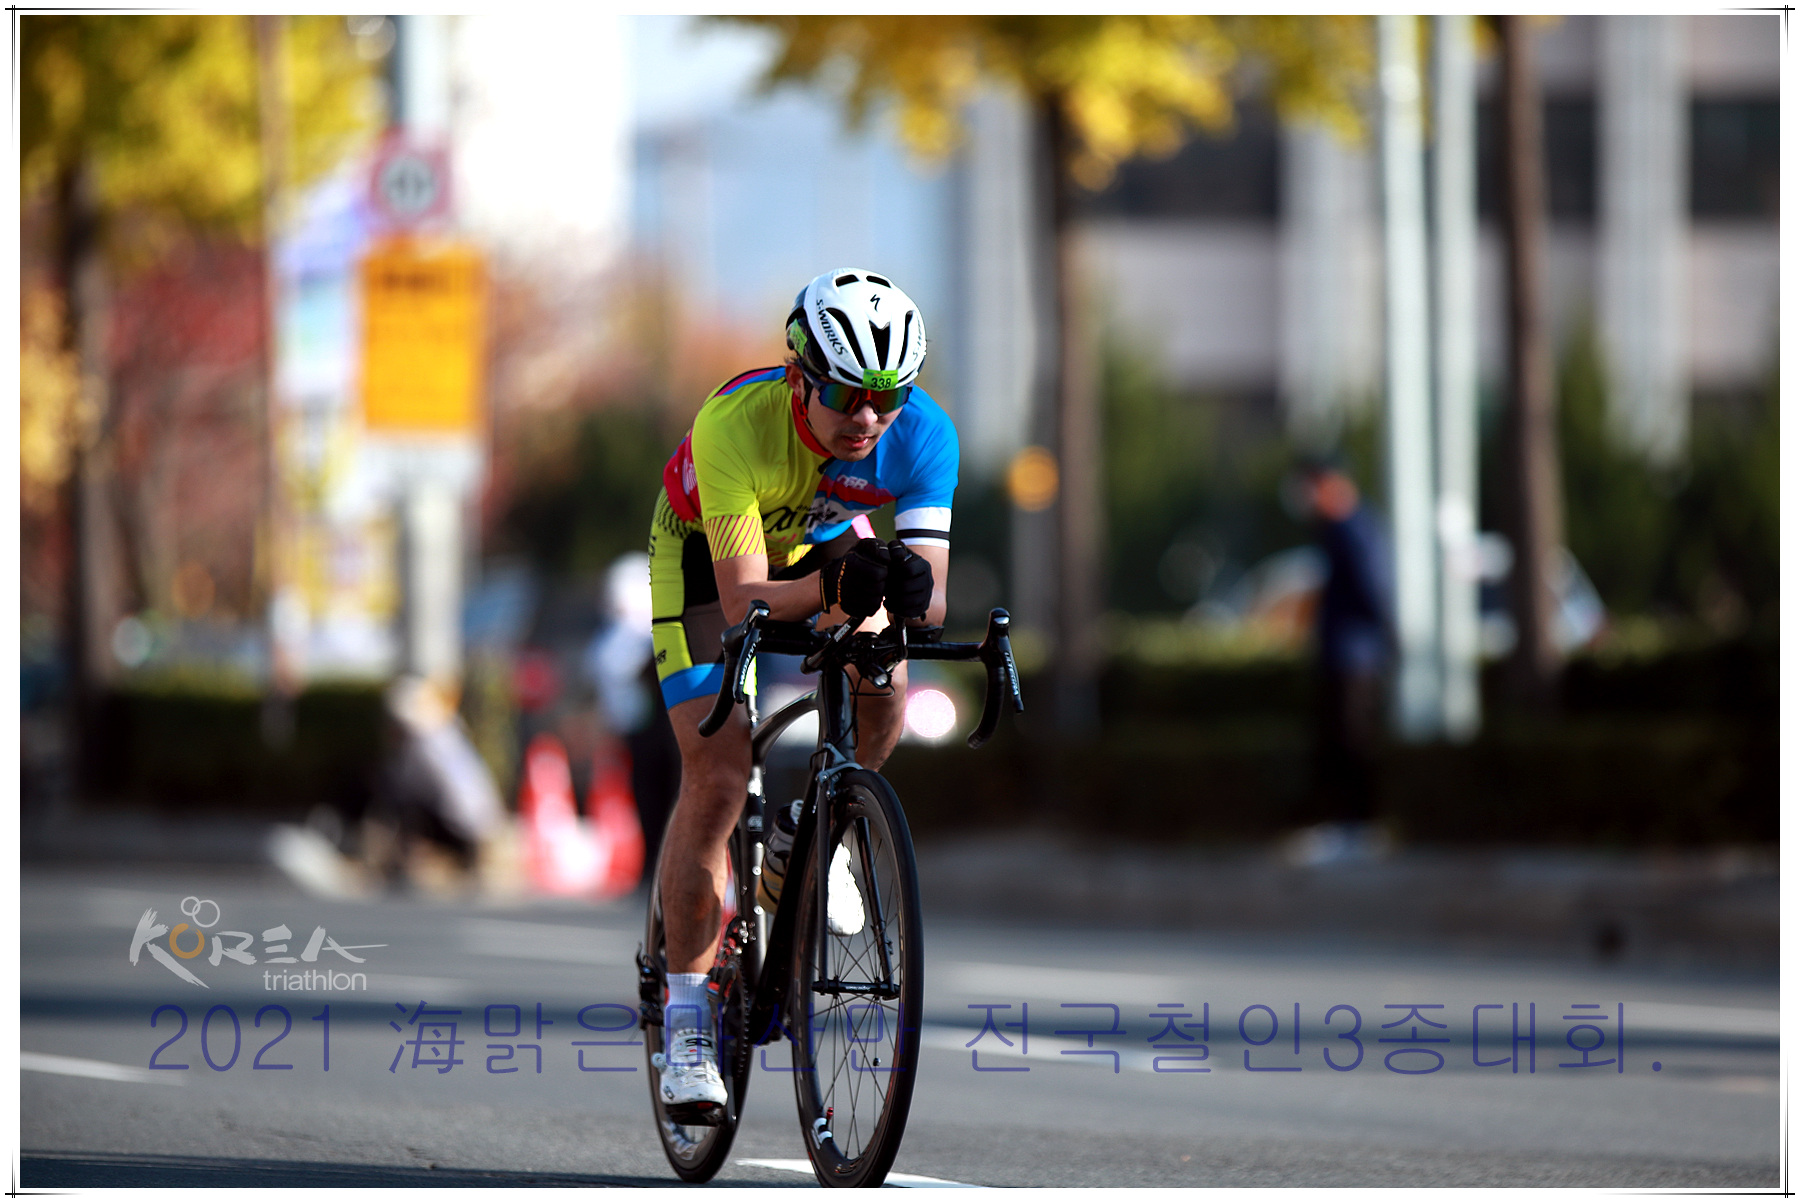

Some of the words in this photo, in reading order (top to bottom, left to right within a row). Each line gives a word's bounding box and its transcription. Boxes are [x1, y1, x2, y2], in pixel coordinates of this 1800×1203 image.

[816, 299, 848, 356] S-WORKS
[870, 377, 892, 390] 338
[1004, 651, 1020, 696] ULTEGRA
